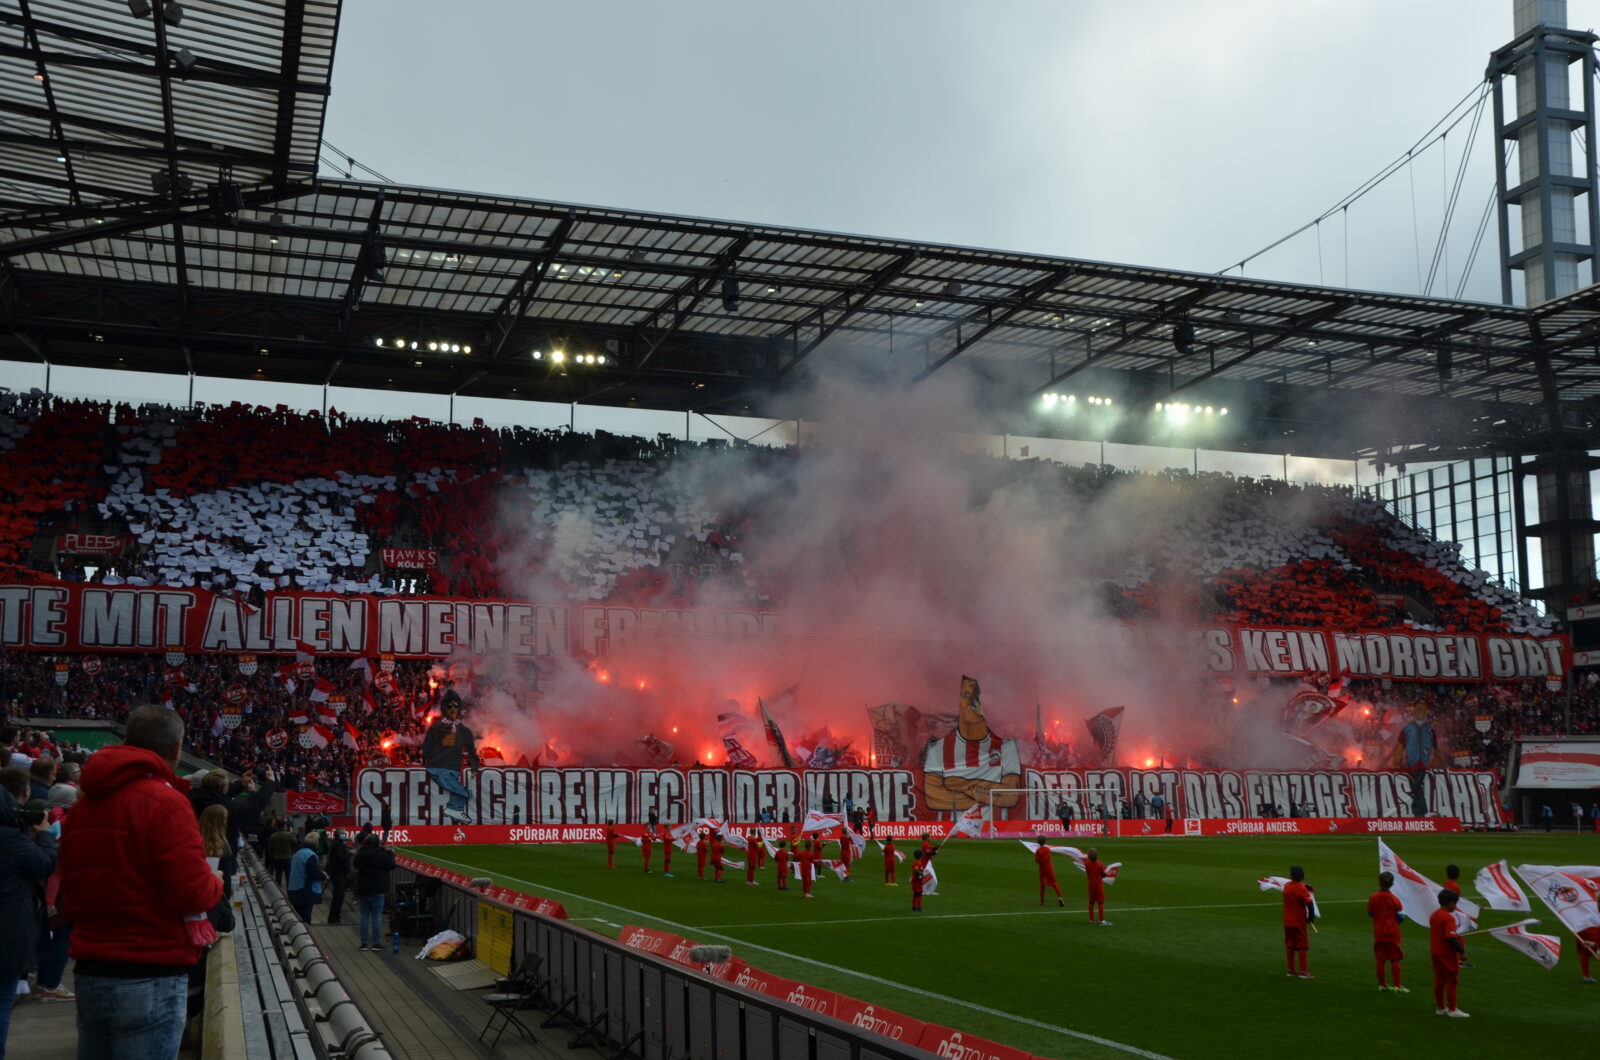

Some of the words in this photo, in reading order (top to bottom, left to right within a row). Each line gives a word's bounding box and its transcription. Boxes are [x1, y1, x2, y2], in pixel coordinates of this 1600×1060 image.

[383, 549, 437, 565] HAWKS
[80, 588, 196, 648] MIT
[201, 594, 368, 653] ALLEN
[378, 600, 571, 656] MEINEN
[1240, 629, 1331, 672] KEIN
[1333, 632, 1483, 680] MORGEN
[1488, 637, 1564, 680] GIBT
[538, 768, 634, 825] BEIM
[638, 768, 687, 825] FC
[689, 769, 731, 823] IN
[733, 769, 803, 823] DER
[804, 769, 916, 822] KURVE
[1026, 768, 1084, 820] DER
[1085, 769, 1128, 820] FC
[1129, 769, 1181, 820] IST
[1183, 769, 1245, 819] DAS
[1246, 771, 1353, 818] EINZIGE
[1350, 771, 1415, 818] WAS
[908, 825, 947, 837] ANDERS.
[1227, 821, 1265, 833] SPÜRBAR
[1266, 820, 1300, 832] ANDERS.
[1367, 820, 1404, 832] SPÜRBAR
[1406, 819, 1437, 831] ANDERS.
[510, 827, 559, 841] SPÜRBAR
[562, 827, 606, 841] ANDERS.
